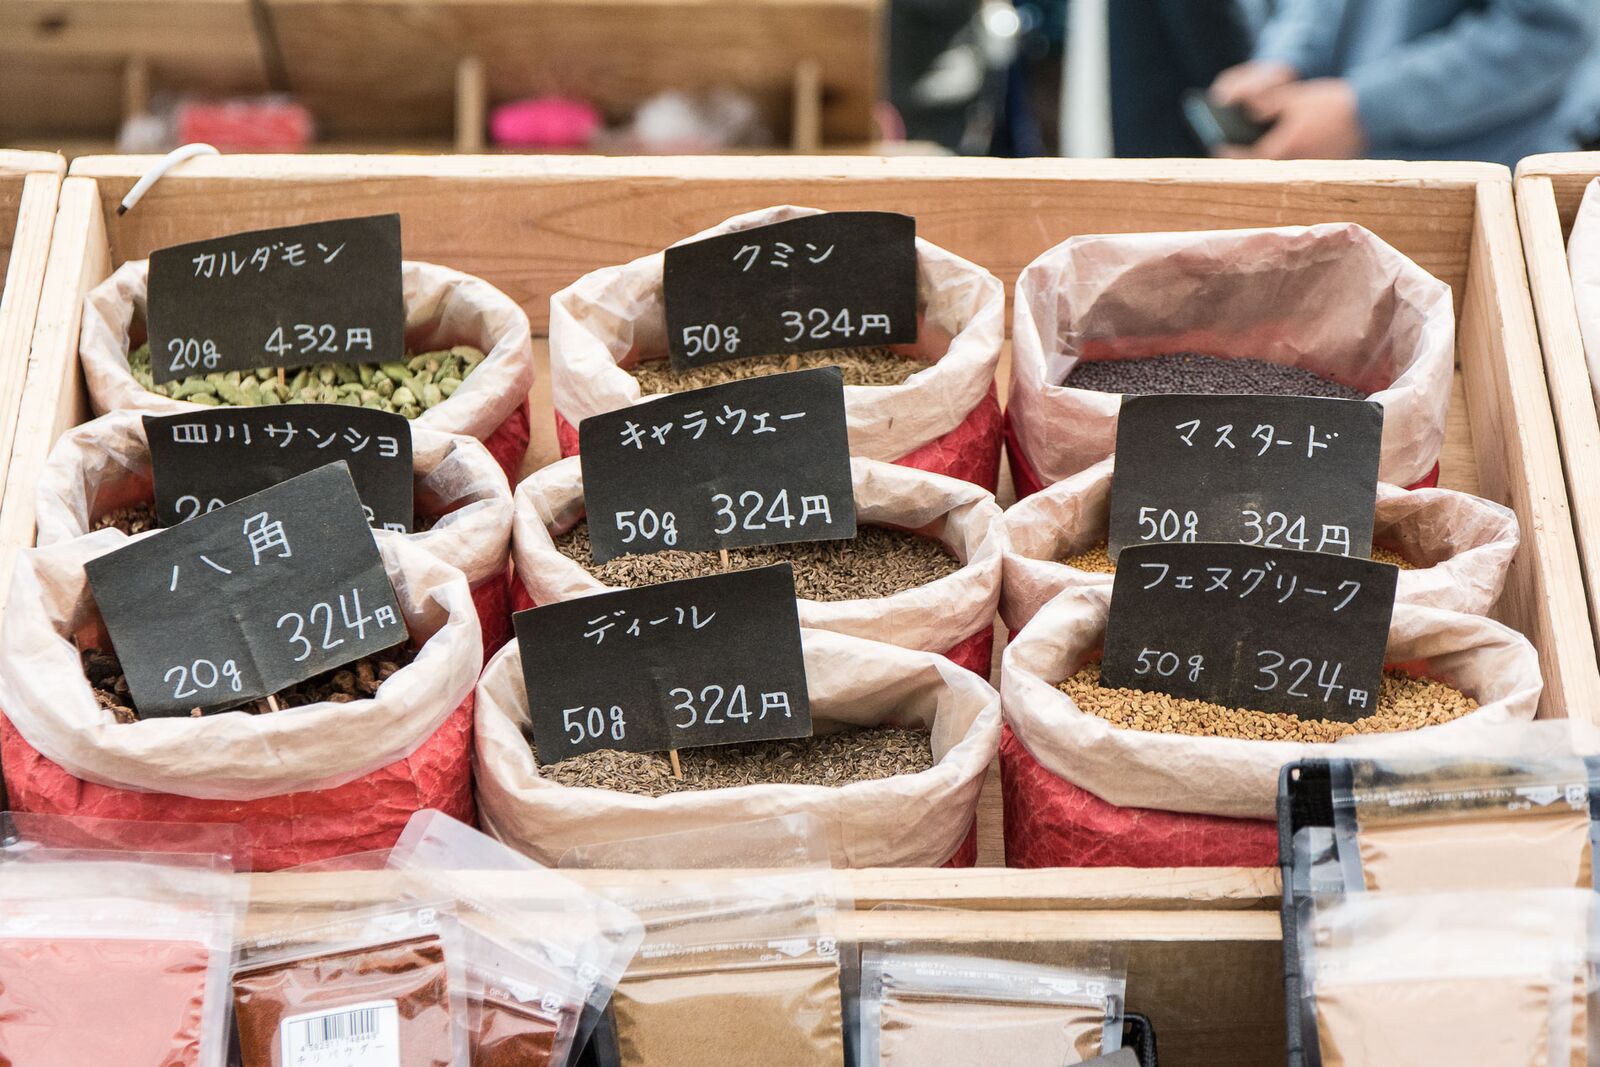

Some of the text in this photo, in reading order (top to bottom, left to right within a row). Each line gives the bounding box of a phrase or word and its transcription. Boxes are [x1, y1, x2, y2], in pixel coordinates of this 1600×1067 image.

[193, 240, 345, 278] カルダモン
[734, 243, 835, 272] クミン
[168, 324, 373, 372] 20g 432円
[682, 308, 891, 357] 50g 324円
[620, 405, 807, 450] キャラウェー
[1176, 419, 1338, 458] マスタード
[615, 489, 833, 545] 50g 324円
[1138, 506, 1351, 557] 50g 324円
[169, 511, 293, 592] 八角
[1140, 561, 1361, 612] フェヌグリーク
[164, 588, 398, 700] 20g 324円
[583, 605, 716, 645] ディール
[1135, 648, 1368, 709] 50g 324円
[563, 685, 792, 745] 50g 324円
